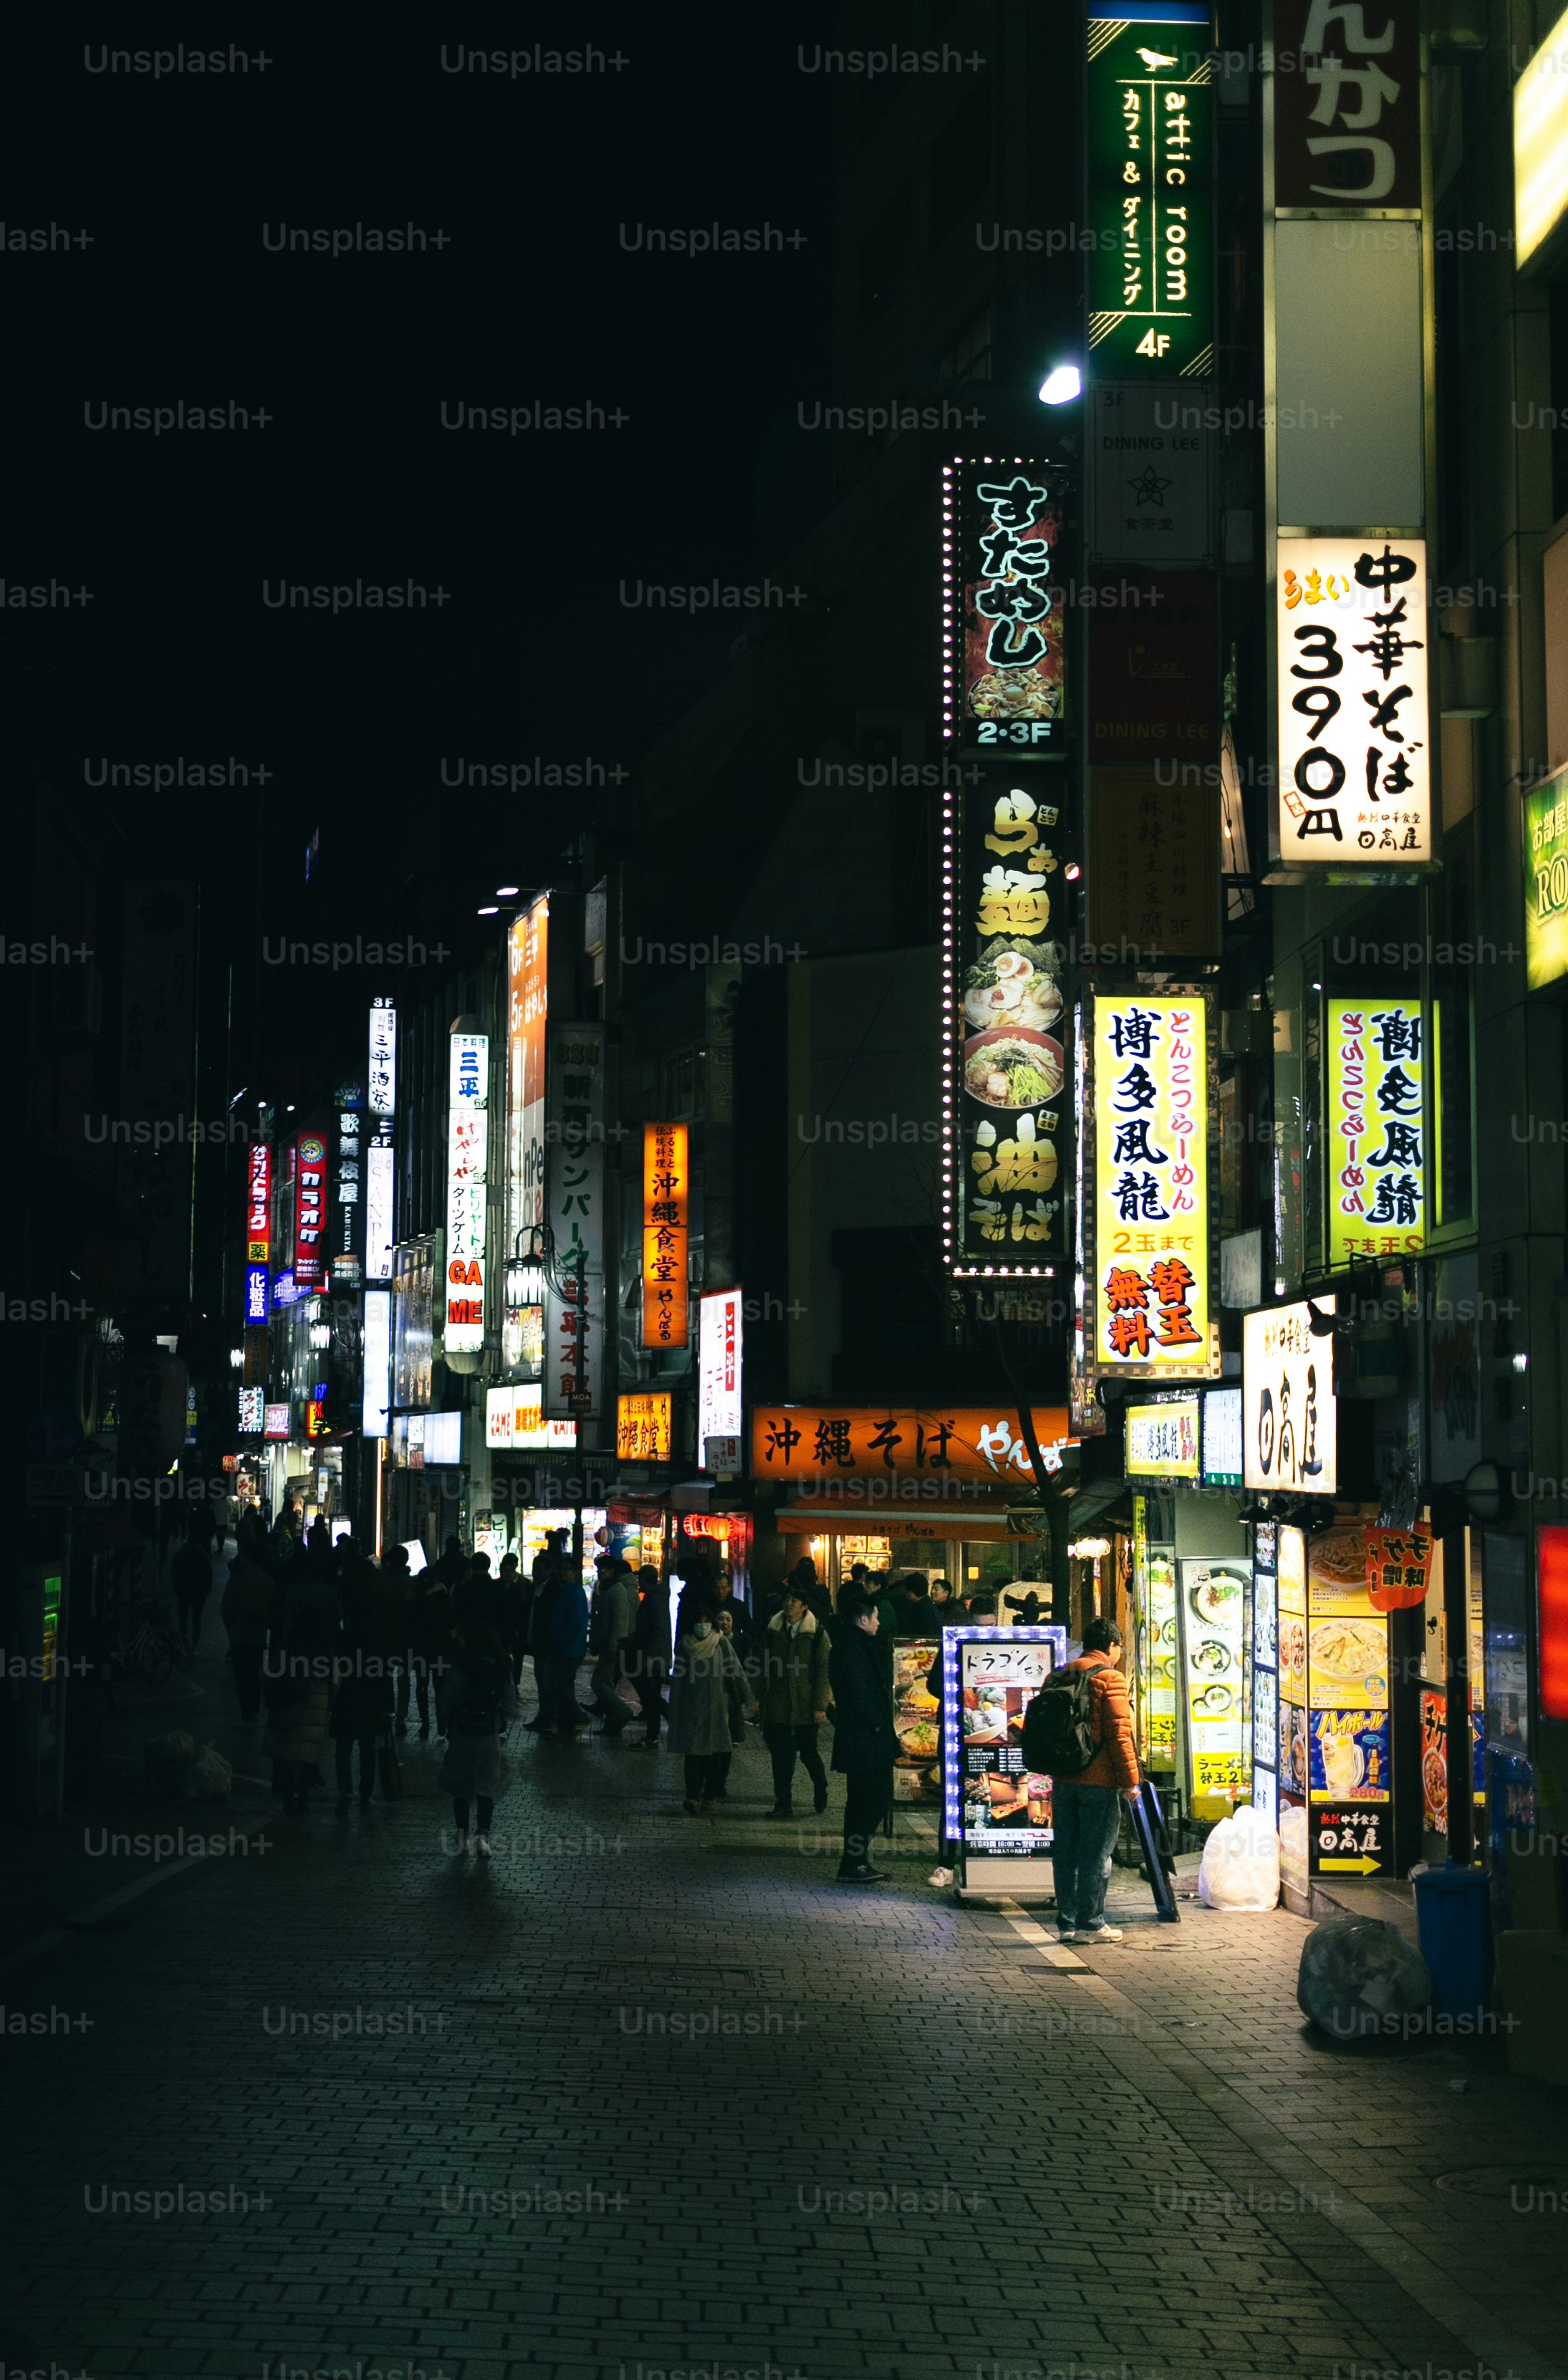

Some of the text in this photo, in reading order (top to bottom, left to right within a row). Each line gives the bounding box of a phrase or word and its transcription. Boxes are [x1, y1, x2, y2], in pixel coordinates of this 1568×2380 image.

[1122, 89, 1140, 149] カフェ
[1166, 91, 1191, 302] attic room
[1122, 196, 1142, 306] ダイニング
[1135, 327, 1170, 358] 4F
[1103, 437, 1199, 450] DINING LEE
[1284, 567, 1350, 610] うまい
[1352, 544, 1424, 802] 中華そば
[1532, 801, 1568, 852] お部屋
[460, 1052, 478, 1098] 三平
[1109, 1007, 1170, 1221] 博多風龍
[1170, 1012, 1194, 1210] とんこつらーめん
[300, 1172, 320, 1243] カラオケ
[650, 1172, 680, 1283] 沖縄食堂
[251, 1244, 266, 1259] 薬
[1113, 1232, 1193, 1253] 2玉まで
[764, 1417, 957, 1469] 沖縄そば
[1317, 1711, 1385, 1740] ハイボール
[1319, 1828, 1381, 1852] 日高屋
